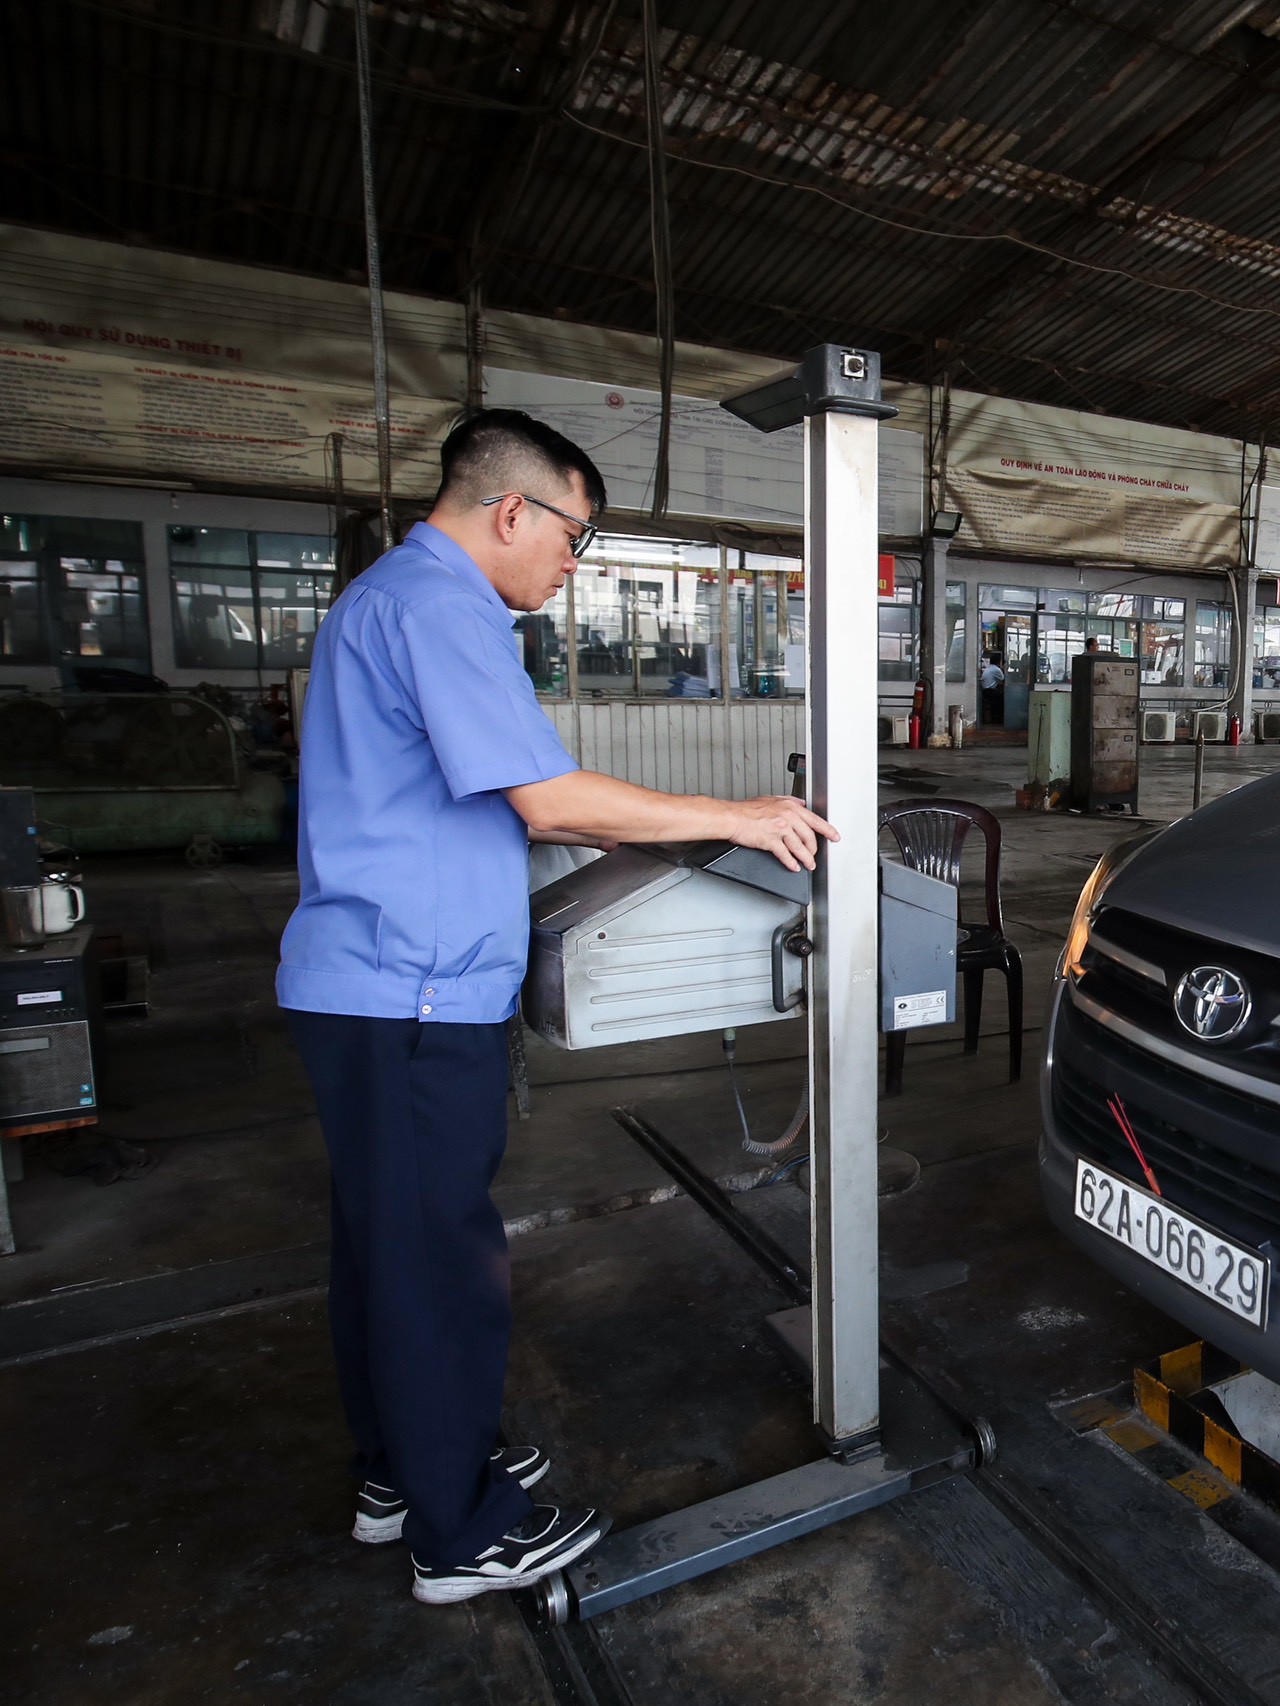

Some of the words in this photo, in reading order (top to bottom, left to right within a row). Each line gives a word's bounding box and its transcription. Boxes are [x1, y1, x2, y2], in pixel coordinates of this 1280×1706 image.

[1000, 458, 1015, 467] QUY
[1016, 460, 1033, 471] ĐỊNH
[1033, 460, 1043, 471] VỀ
[1044, 464, 1054, 472] AN
[1056, 465, 1074, 475] TOÀN
[1075, 469, 1087, 477] LAO
[1088, 469, 1106, 481] ĐỘNG
[1107, 471, 1116, 481] VÀ
[1117, 474, 1139, 485] PHÒNG
[1139, 477, 1156, 487] CHÁY
[1156, 479, 1173, 490] CHỮA
[1173, 482, 1190, 492] CHÁY
[1080, 1167, 1259, 1315] 62A-066.29
